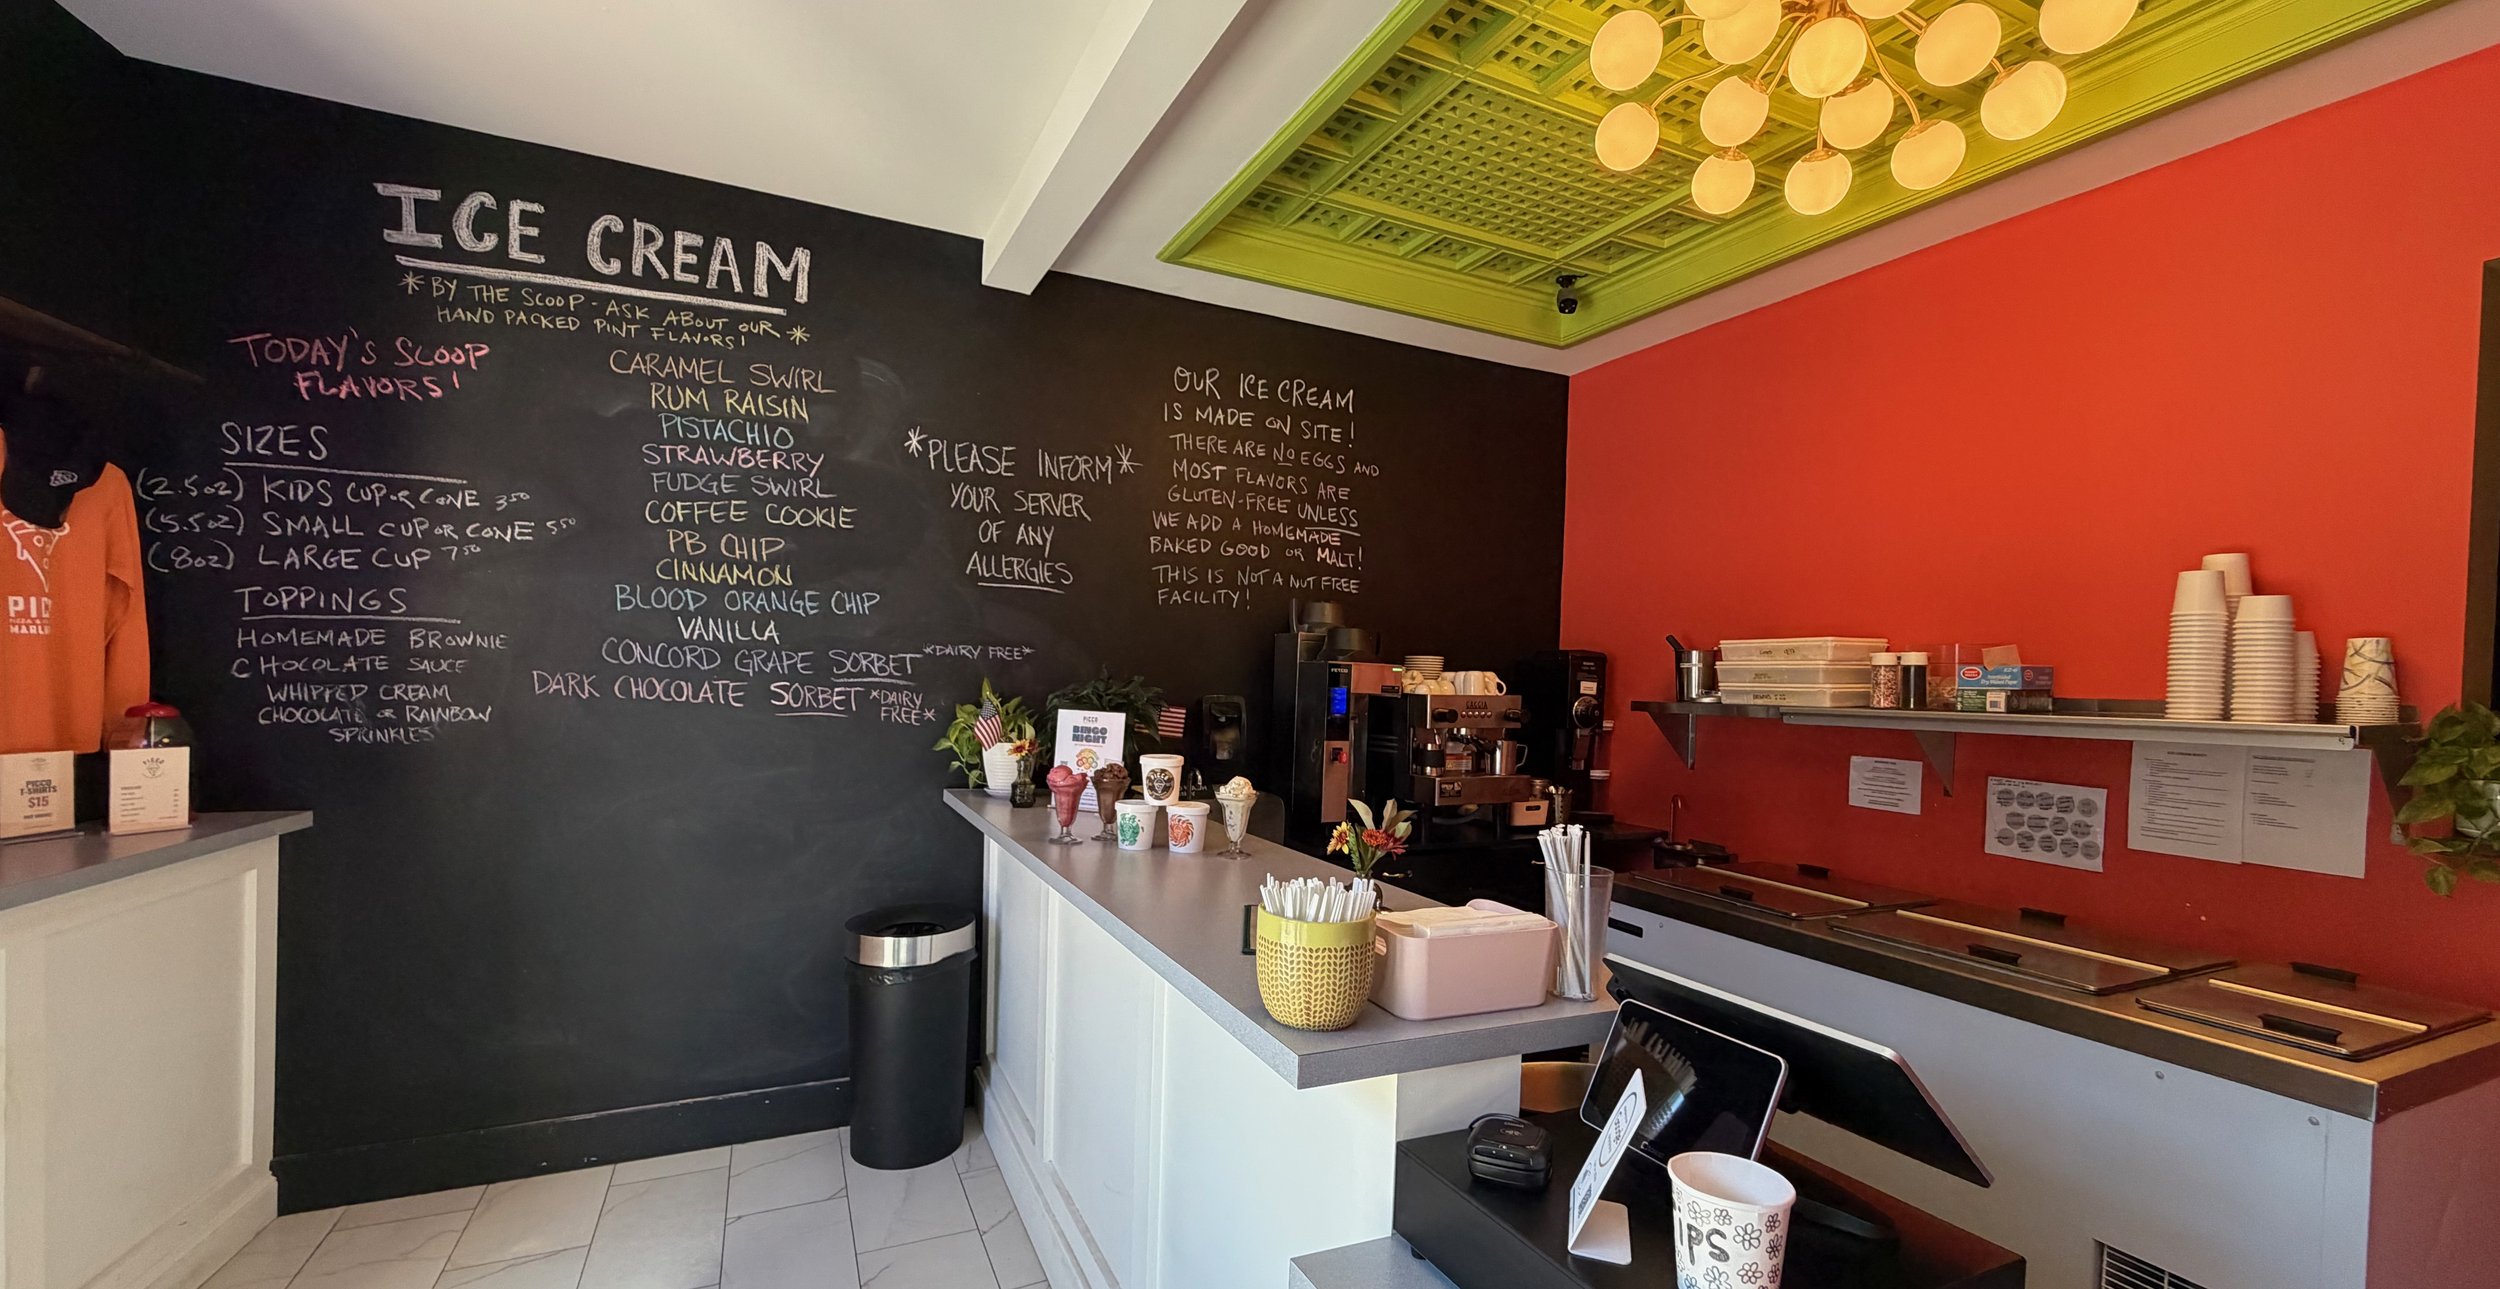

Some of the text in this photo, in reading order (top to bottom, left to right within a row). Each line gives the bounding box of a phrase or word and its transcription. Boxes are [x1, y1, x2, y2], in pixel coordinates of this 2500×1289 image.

[373, 182, 811, 304] ICE CREAM
[466, 283, 510, 304] THE
[521, 287, 586, 312] SCOOP
[605, 299, 650, 320] ASK
[662, 308, 729, 332] ABOUT
[436, 304, 748, 350] HAND PACKED PINT FLAVORS!
[227, 325, 490, 373] TODAY'S SCOOP
[608, 349, 838, 394] CARAMEL SWIRL
[1173, 365, 1355, 414] OUR ICE CREAM
[650, 381, 810, 424] RUM RAISIN
[1164, 402, 1184, 423] IS
[1195, 404, 1256, 428] MADE
[1264, 413, 1292, 437] ON
[220, 420, 329, 462] SIZES
[658, 412, 796, 450] PISTACHIO
[640, 442, 826, 478] STRAWBERRY
[1168, 432, 1380, 478] THERE ARE NO EGGS AND
[262, 473, 334, 508] KIDS
[346, 482, 387, 508] CUP
[418, 487, 481, 510] CONE
[650, 471, 838, 499] FUDGE SWIRL
[1172, 457, 1351, 503] MOST FLAVORS ARE
[644, 500, 859, 530] COFFEE COOKIE
[950, 481, 1093, 523] YOUR SERVER
[1166, 484, 1360, 528] GLUTEN-FREE UNLESS
[261, 510, 365, 540] SMALL
[377, 517, 431, 540] CUP
[465, 520, 536, 543] CONE
[977, 518, 1056, 558] OF ANY
[1151, 510, 1342, 547] WE ADD A HOMEMADE
[257, 543, 363, 572] LARGE
[370, 547, 432, 571] CUP
[665, 528, 786, 562] PB CHIP
[1149, 535, 1363, 572] BAKED GOOD OR MALT!
[654, 557, 794, 588] CINNAMON
[964, 550, 1075, 586] ALLERGIES
[1151, 564, 1362, 595] THIS IS NOT A NUT FREE
[232, 584, 409, 615] TOPPINGS
[614, 583, 881, 618] BLOOD ORANGE CHIP
[236, 626, 510, 651] HOMEMADE BROWNIE
[676, 615, 781, 646] VANILLA
[230, 654, 470, 679] CHOCOLATE SAUCE
[601, 636, 722, 672] CONCORD
[733, 649, 815, 678] GRAPE
[827, 649, 924, 678] SORBET
[266, 682, 453, 704] WHIPPED CREAM
[531, 669, 602, 700] DARK
[613, 673, 750, 708] CHOCOLATE
[768, 680, 866, 712] SORBET
[257, 704, 493, 726] CHOCOLATE OR RAINBOW
[1072, 725, 1108, 736] BINGO
[327, 724, 436, 746] SPRINKLES
[1072, 733, 1108, 744] NIGHT
[28, 796, 49, 809] $15
